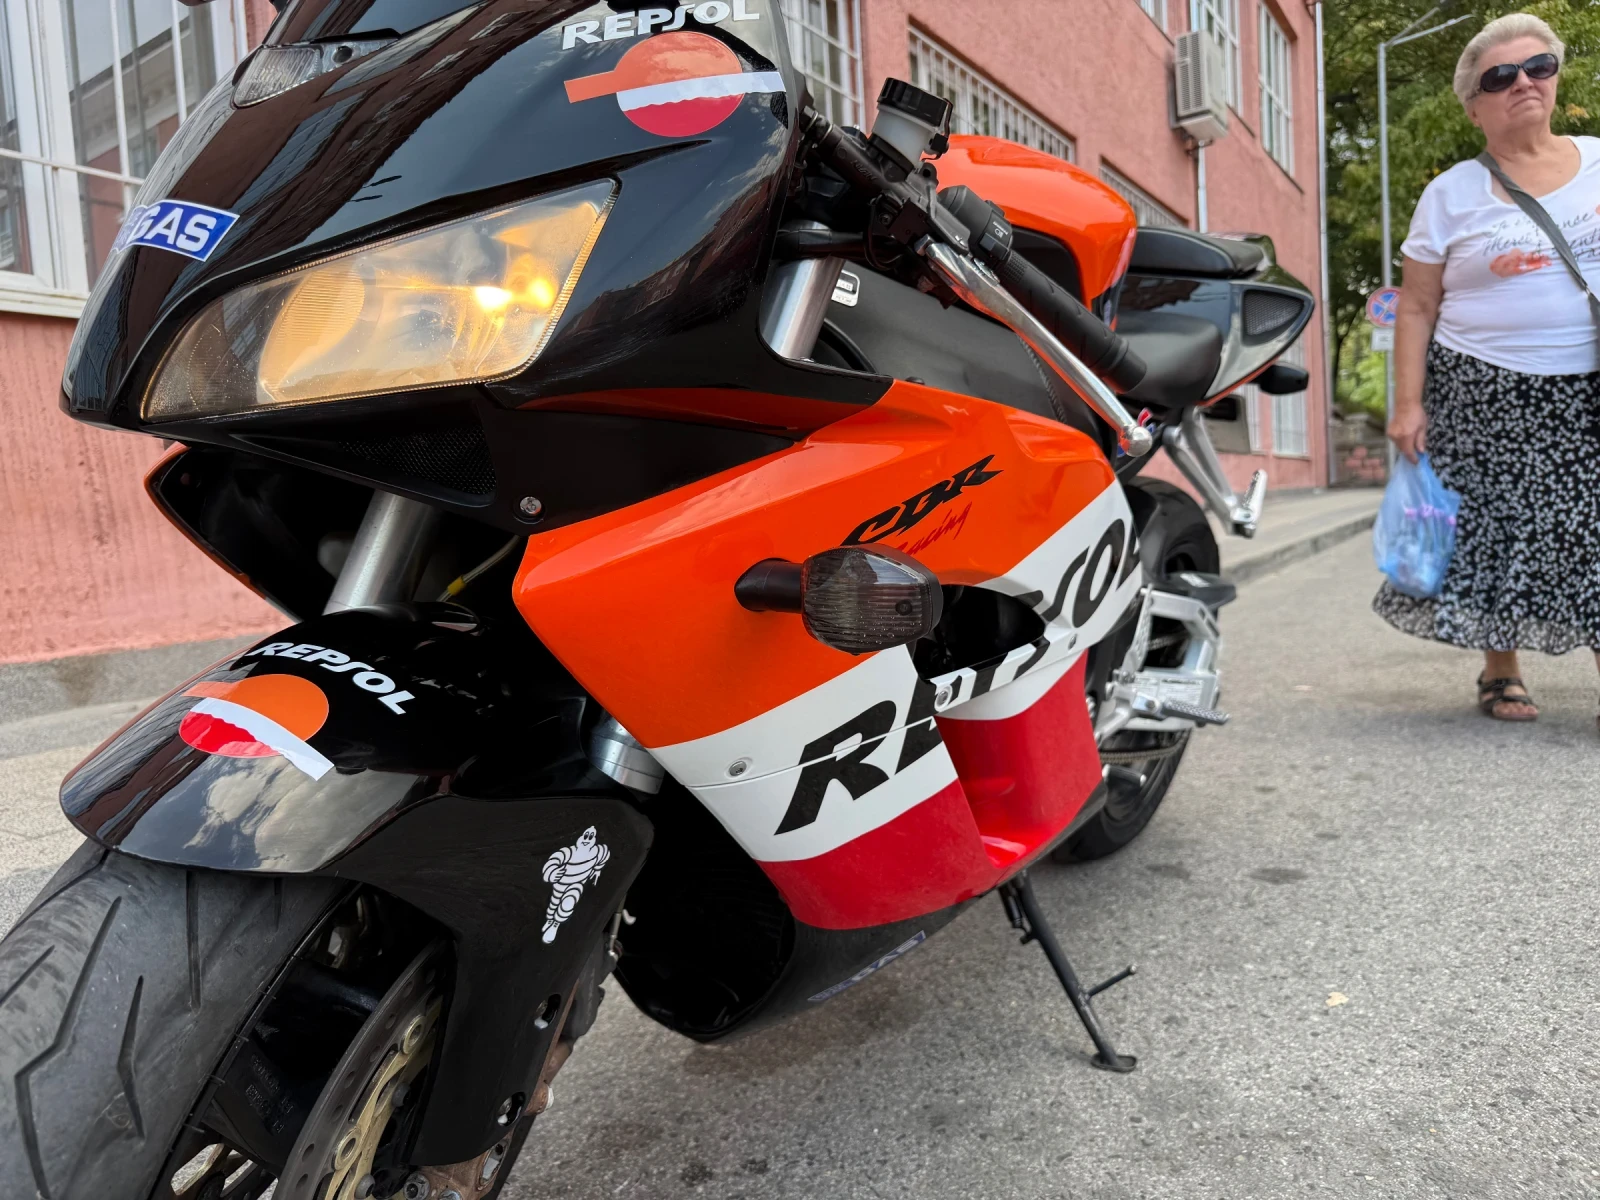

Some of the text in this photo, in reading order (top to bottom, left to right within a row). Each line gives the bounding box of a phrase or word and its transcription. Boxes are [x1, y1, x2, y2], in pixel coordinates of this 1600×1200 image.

[562, 0, 760, 50] REPSOL
[126, 205, 218, 253] GAS
[839, 454, 1004, 546] CBR
[244, 642, 416, 715] REPSOL
